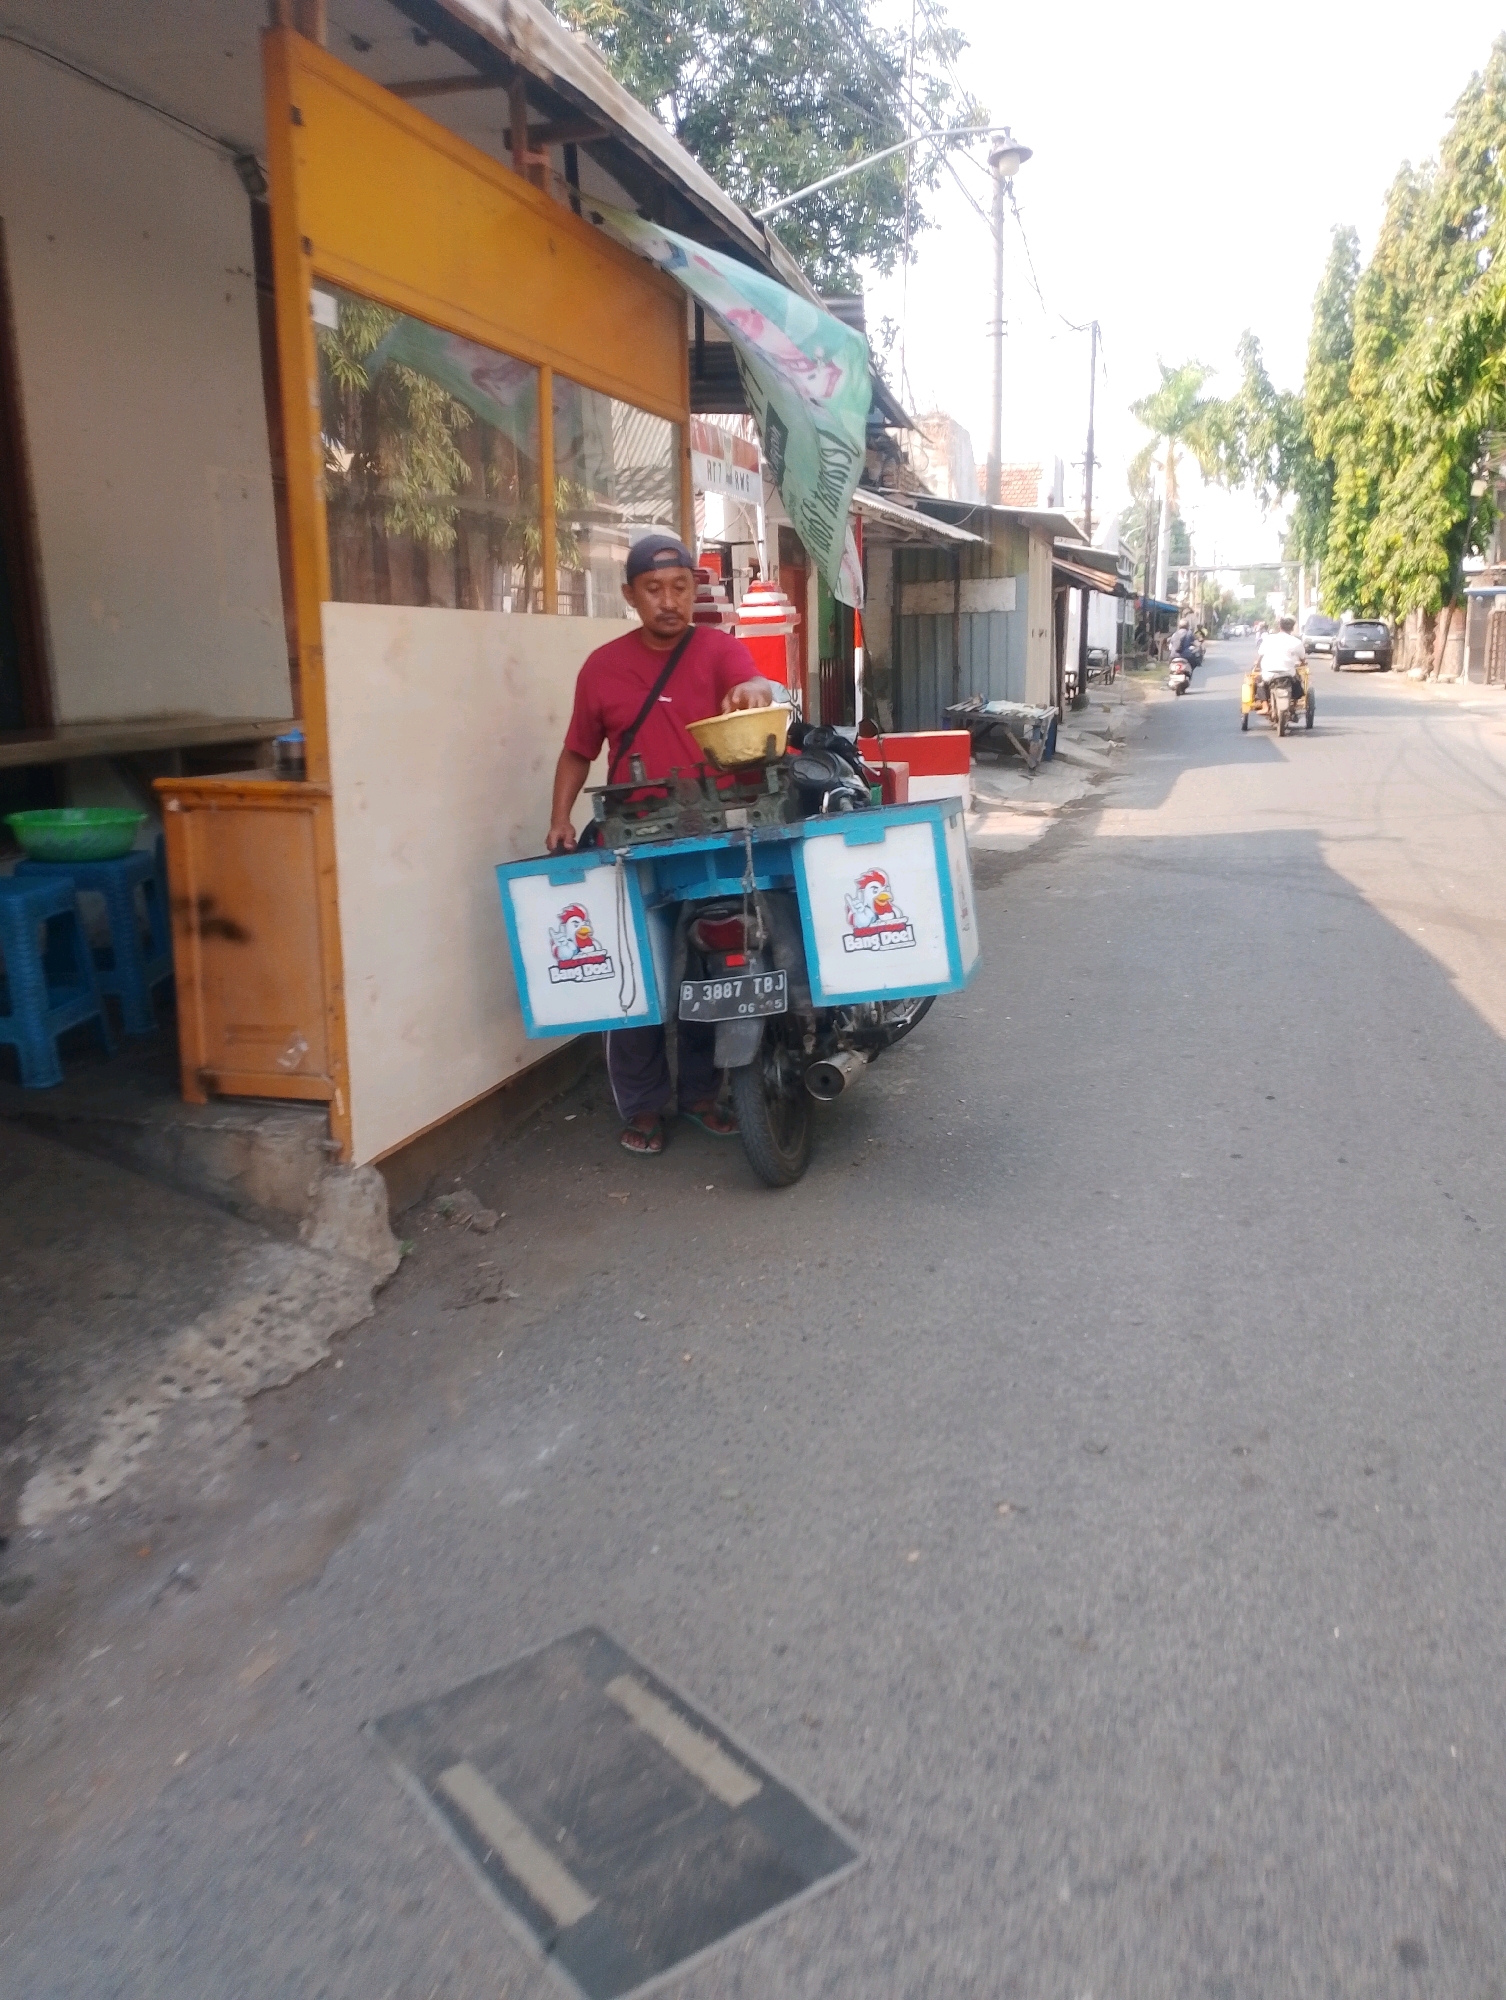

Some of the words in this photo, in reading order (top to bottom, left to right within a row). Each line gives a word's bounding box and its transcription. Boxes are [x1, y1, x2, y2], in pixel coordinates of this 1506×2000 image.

[844, 935, 880, 951] Bang
[880, 926, 914, 946] Doel
[682, 985, 694, 1001] B
[752, 974, 784, 995] TBJ
